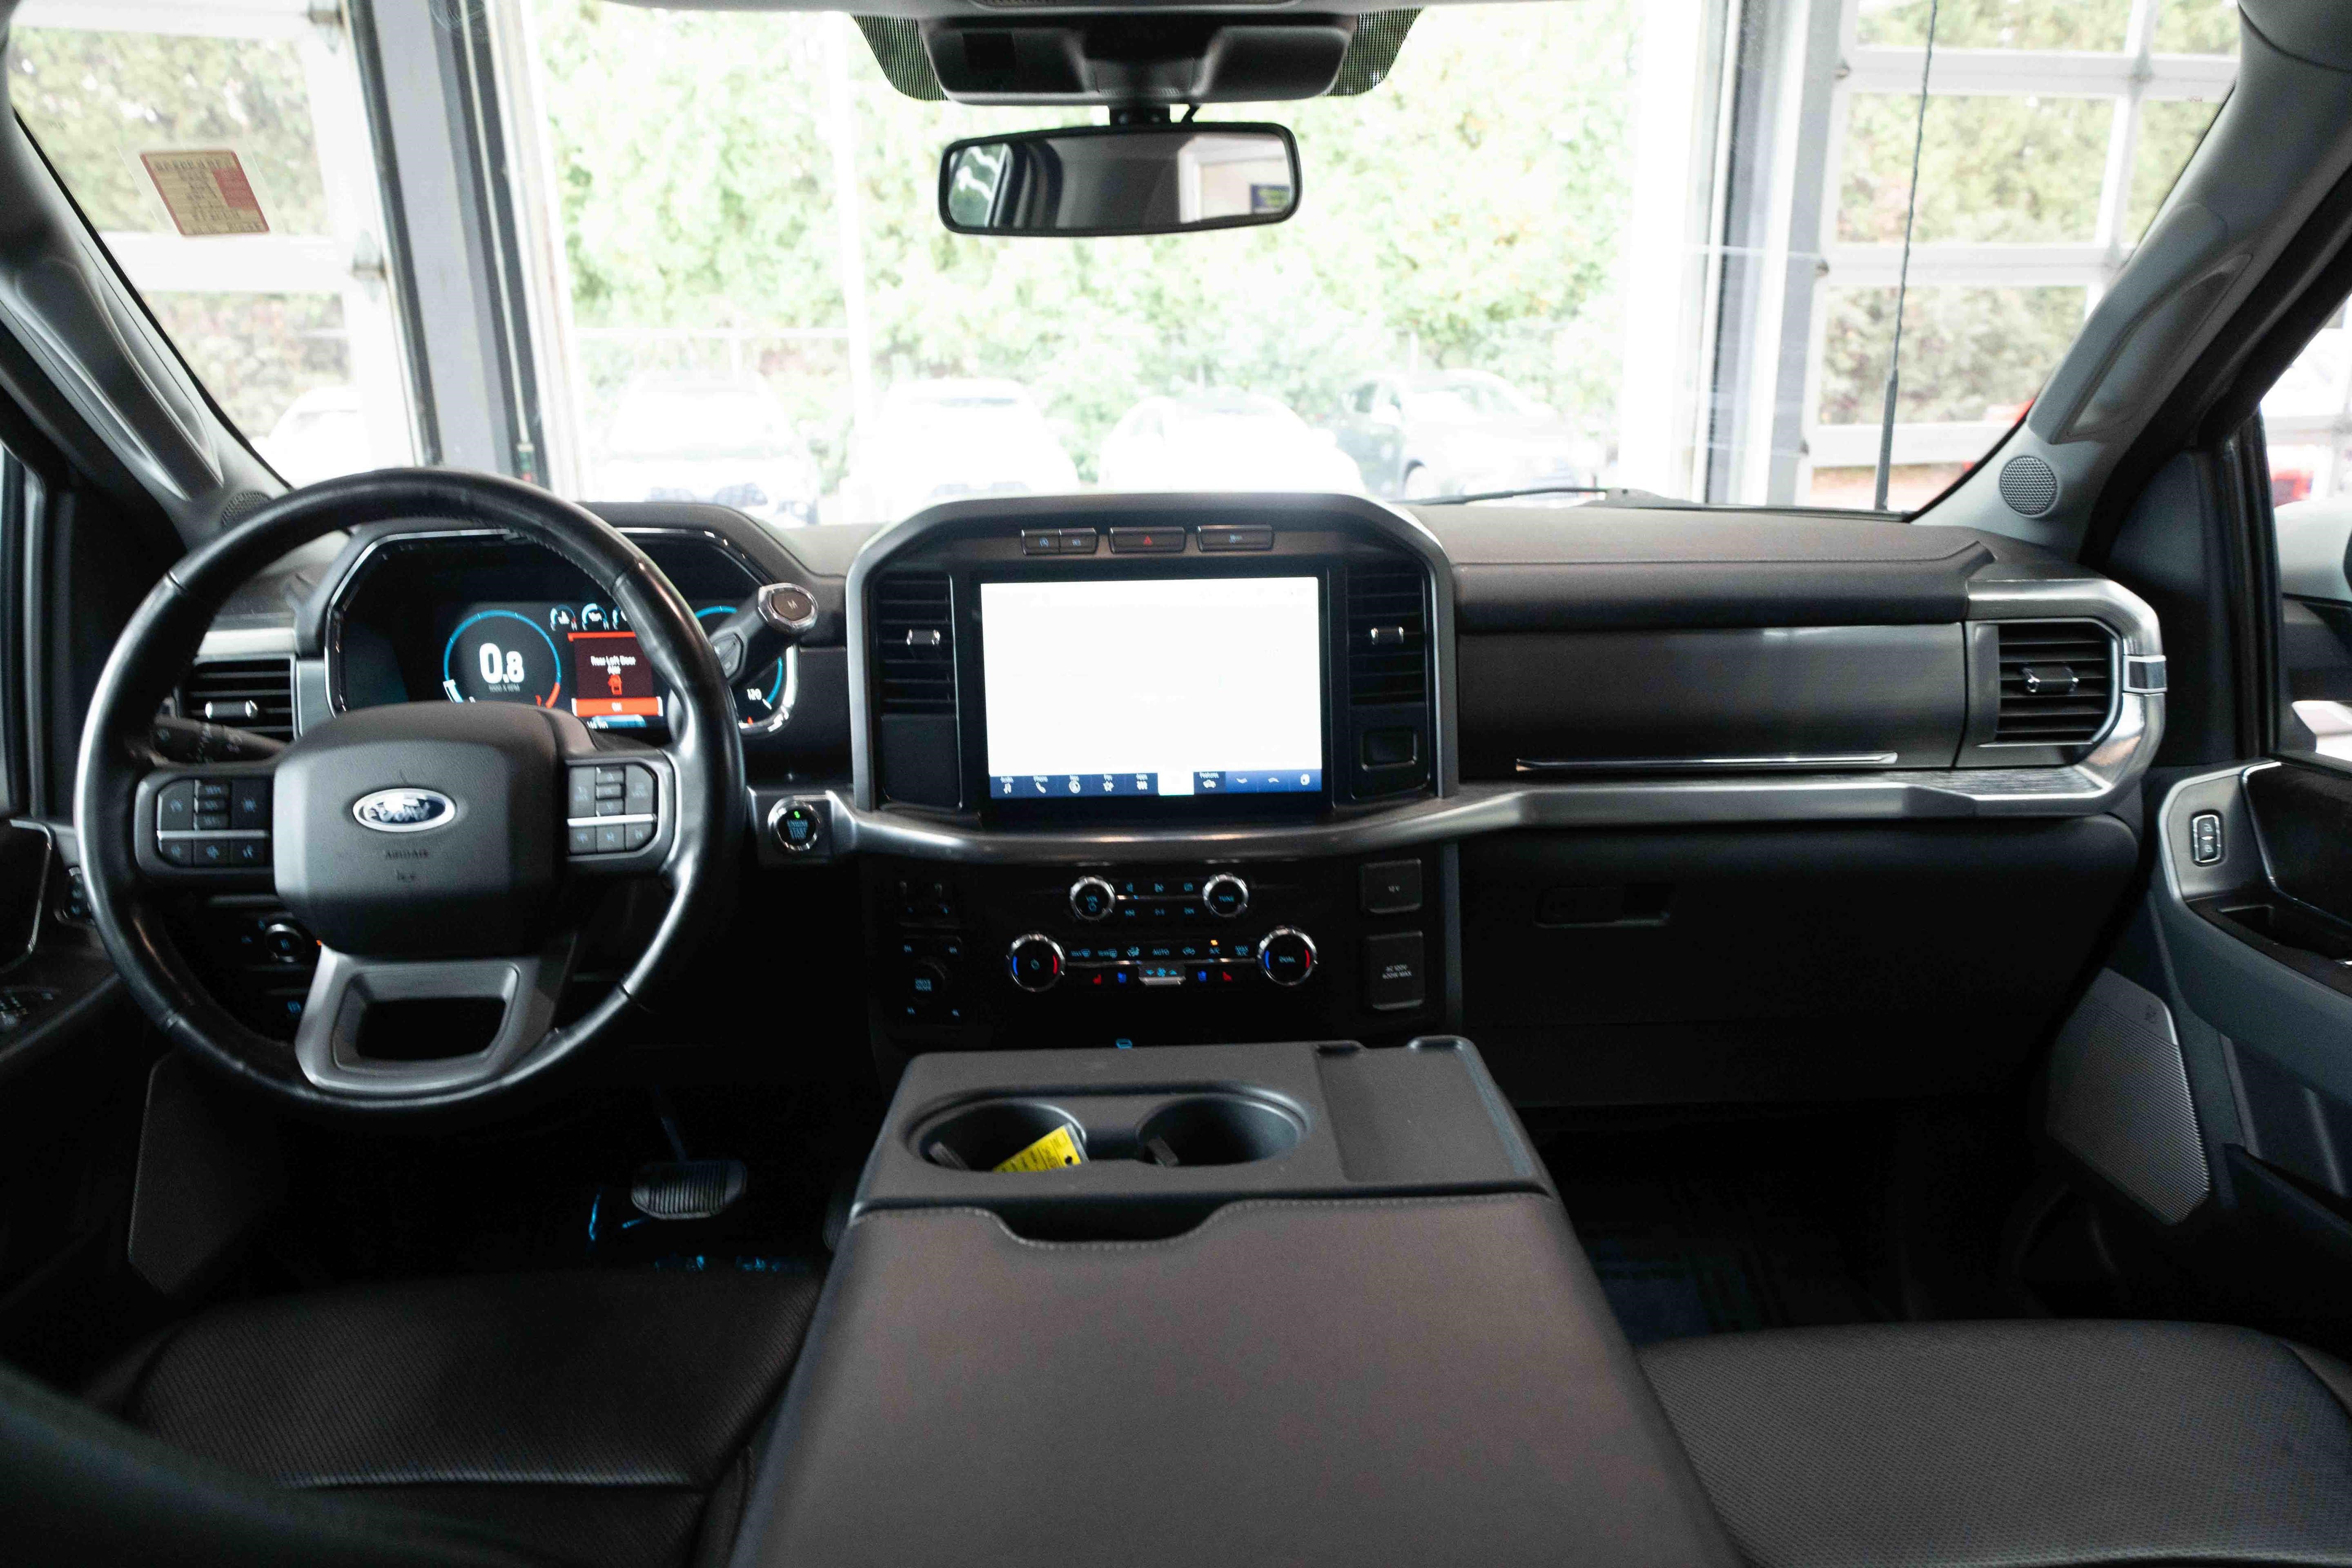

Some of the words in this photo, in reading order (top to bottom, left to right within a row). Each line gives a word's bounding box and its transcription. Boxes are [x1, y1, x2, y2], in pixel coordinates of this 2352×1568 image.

[479, 643, 525, 684] 0.8
[619, 655, 636, 666] Door
[1152, 947, 1170, 956] AUTO
